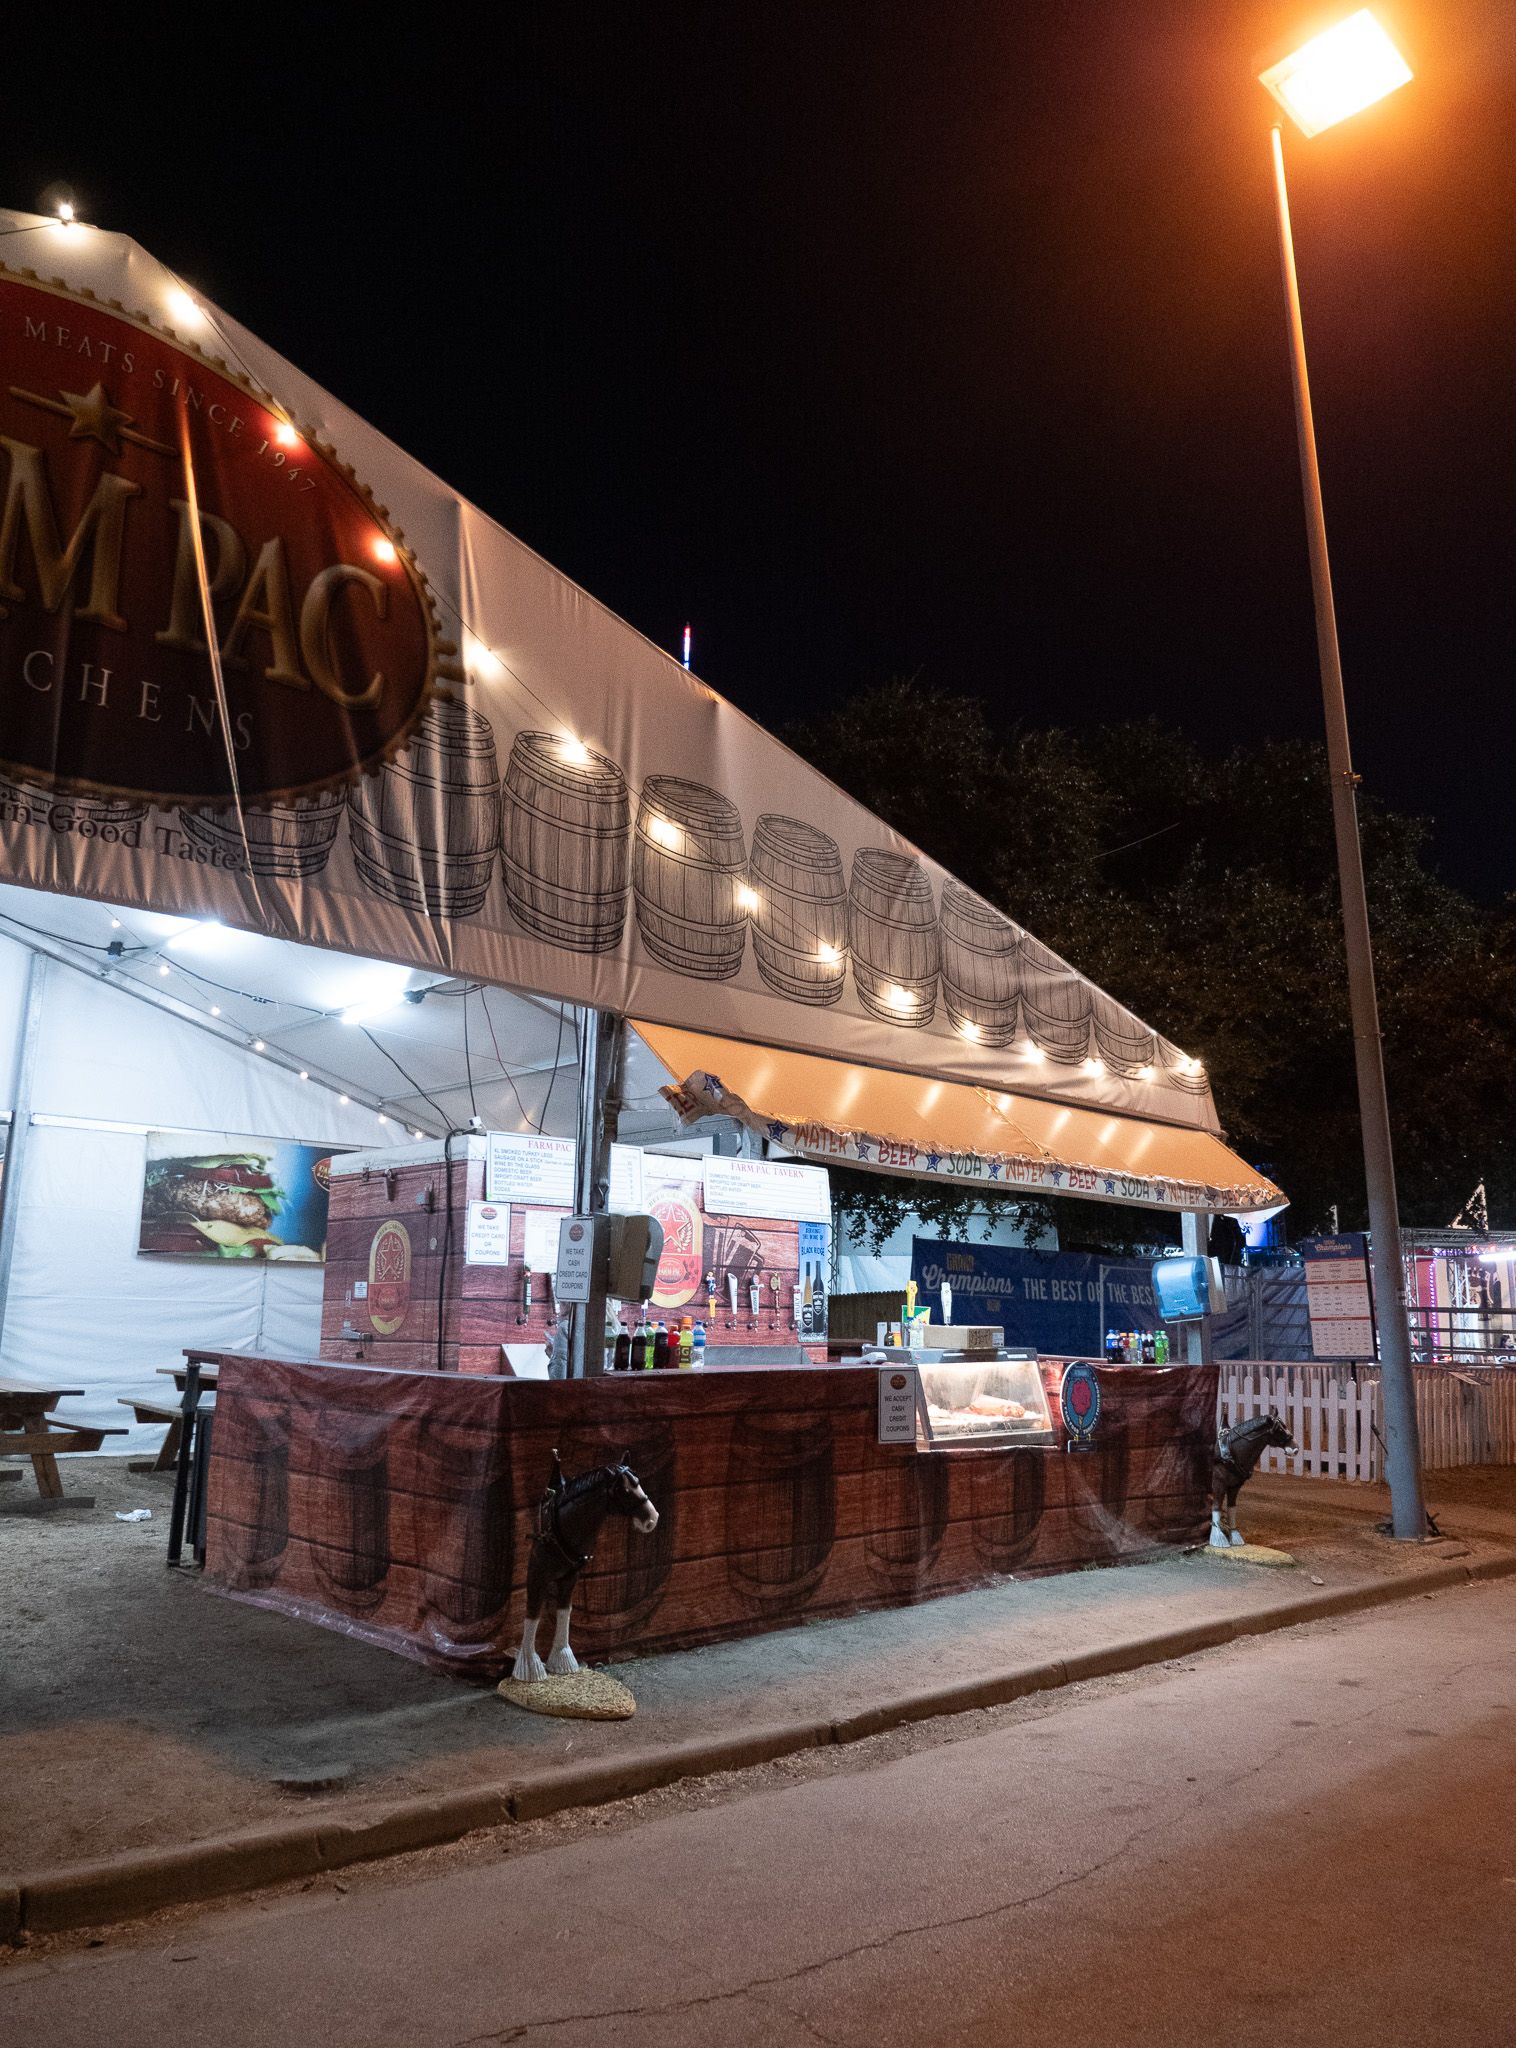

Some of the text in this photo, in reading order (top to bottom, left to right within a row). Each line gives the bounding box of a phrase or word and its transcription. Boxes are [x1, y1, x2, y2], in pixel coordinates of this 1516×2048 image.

[24, 316, 317, 495] MEATS SINCE 1947
[155, 497, 388, 710] PAC
[48, 804, 143, 849] Good
[527, 1140, 572, 1153] FARM PAC
[731, 1161, 804, 1179] FARM PAC TAVERN
[793, 1125, 848, 1155] WATER
[878, 1140, 918, 1167] BEER
[946, 1152, 982, 1178] SODA
[1005, 1160, 1045, 1184] WATER
[1068, 1166, 1097, 1190] BEER
[1119, 1178, 1150, 1200] SODA
[1168, 1183, 1203, 1206] WATER
[565, 1248, 585, 1256] WE TAKE
[801, 1246, 825, 1257] BLACK RIDGE
[568, 1259, 580, 1267] CASH
[558, 1270, 588, 1278] CREDIT CARD
[561, 1282, 584, 1290] COUPONS
[922, 1264, 1015, 1297] Champions
[1022, 1277, 1050, 1301] THE
[1051, 1279, 1083, 1303] BEST
[1106, 1282, 1127, 1304] THE
[681, 1347, 689, 1356] G
[889, 1414, 907, 1423] CREDIT
[885, 1425, 911, 1433] COUPONS
